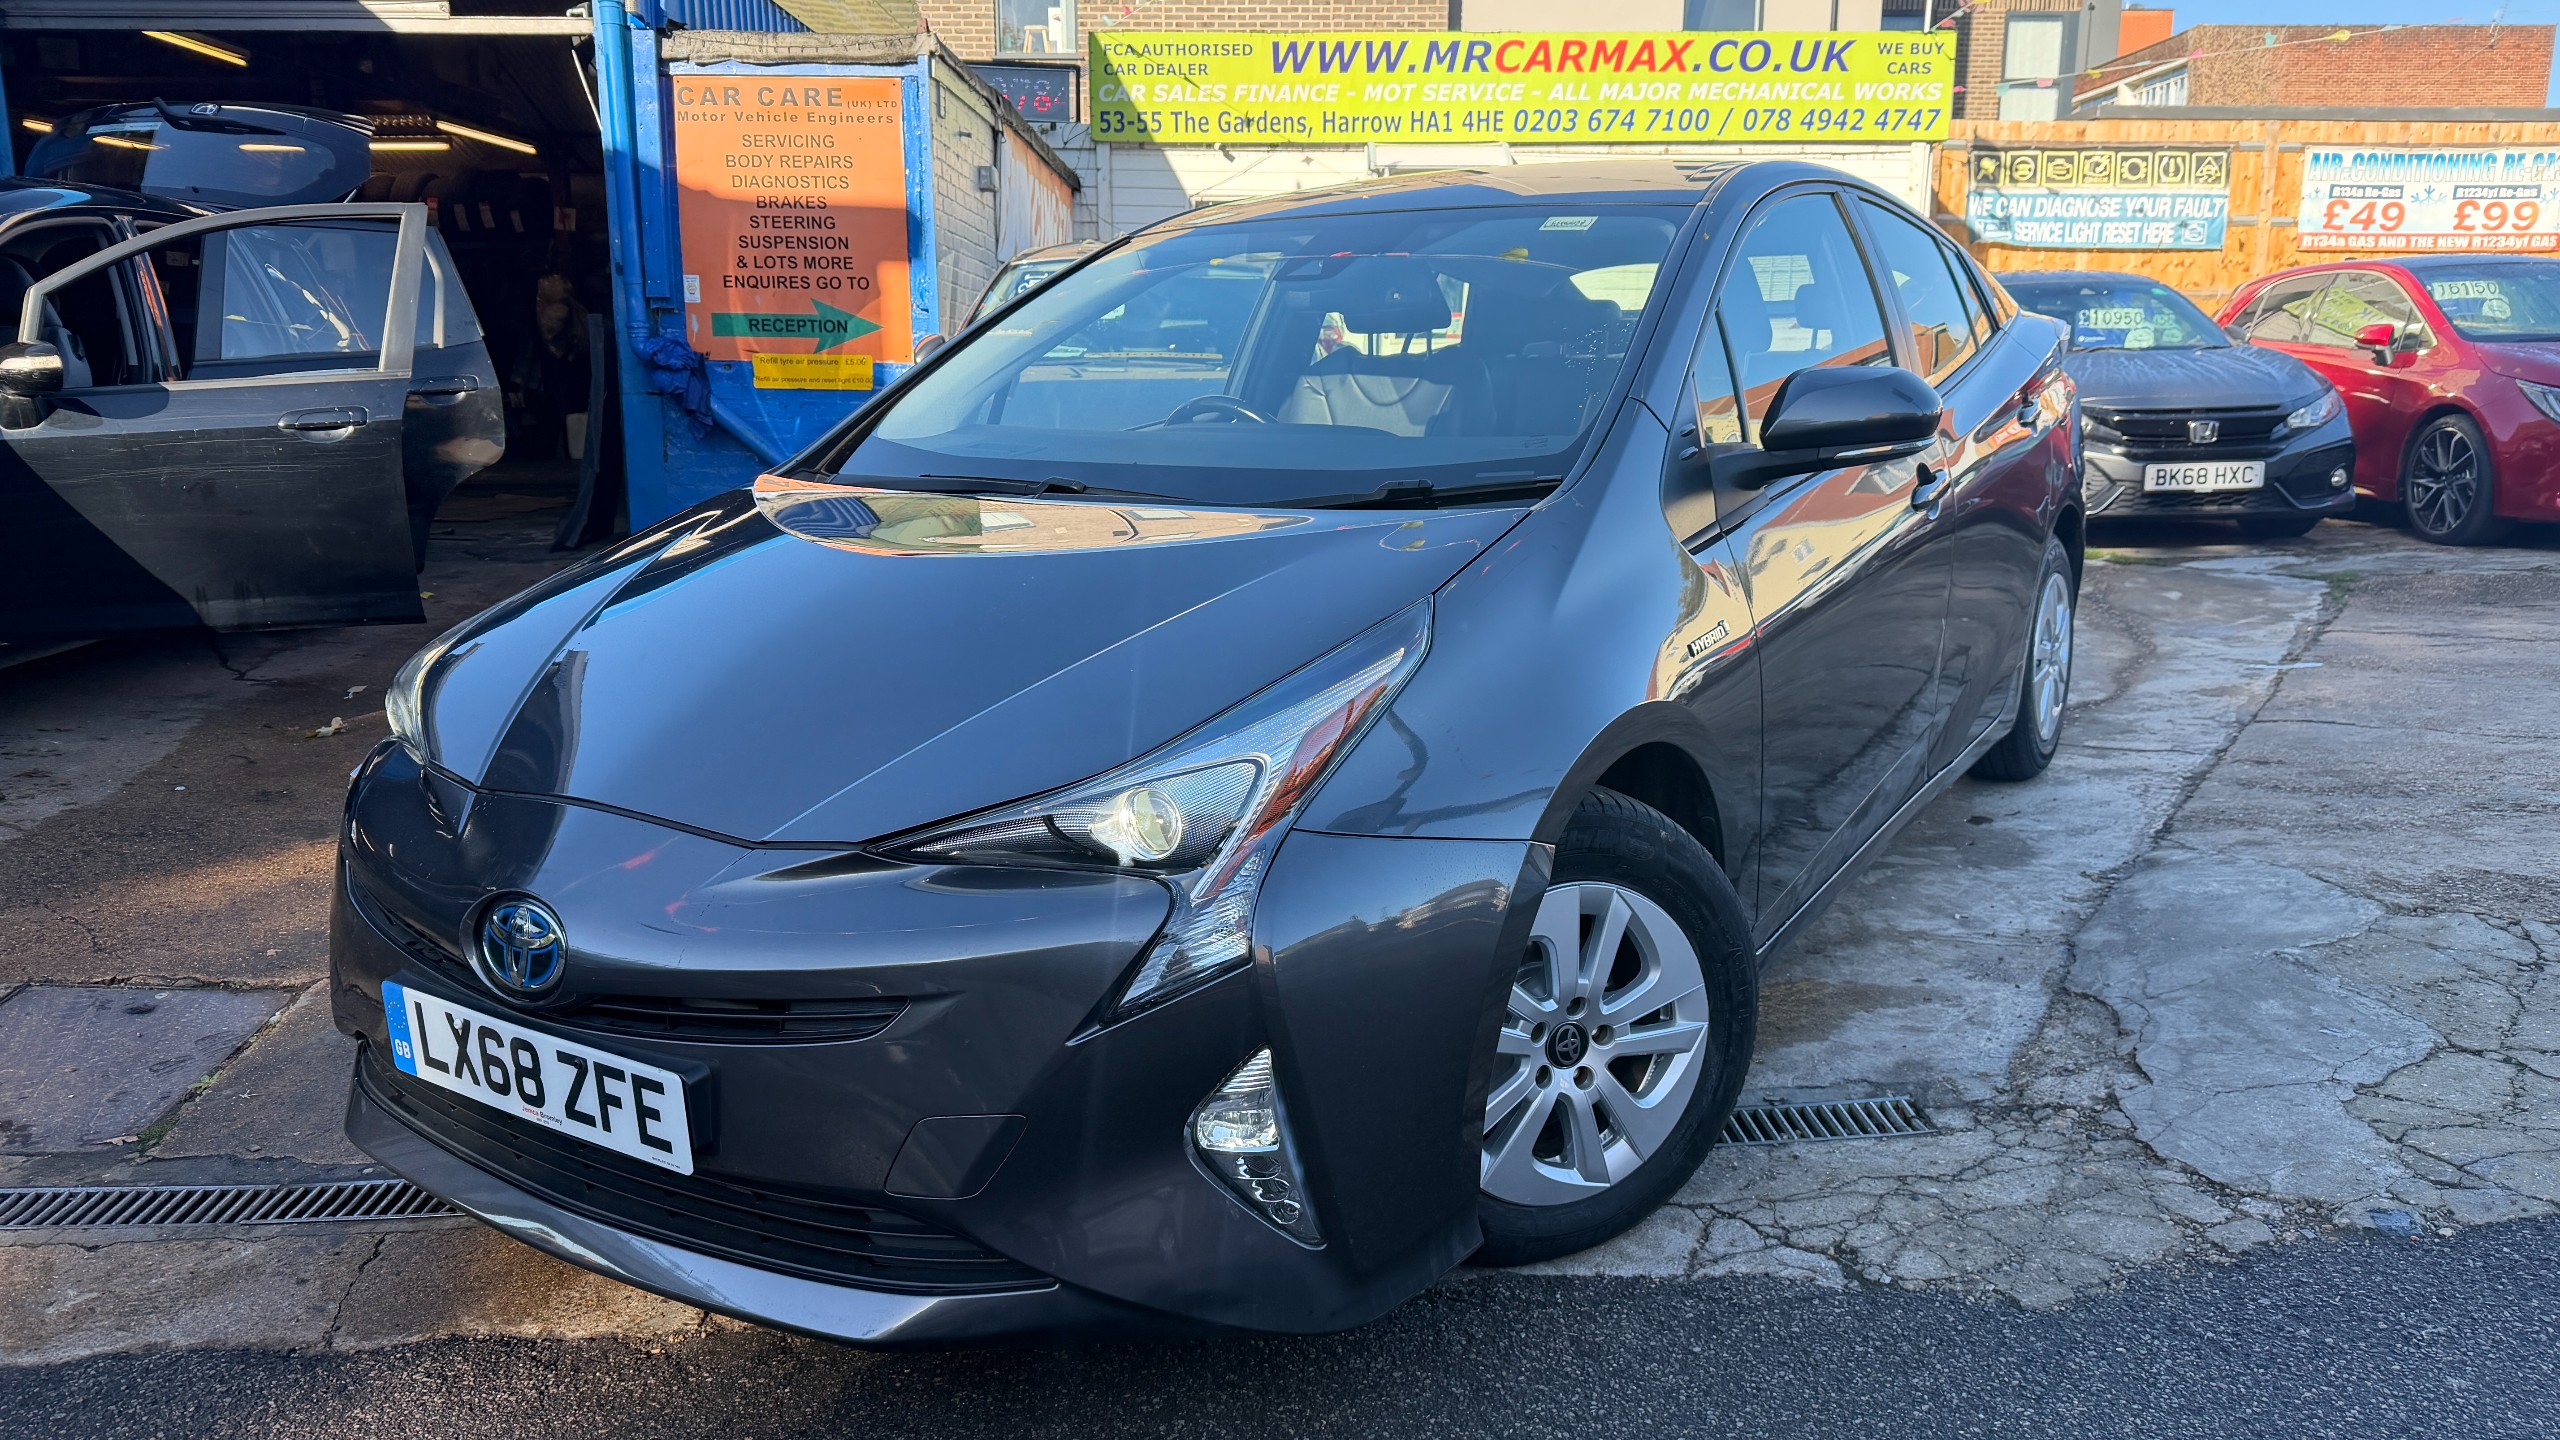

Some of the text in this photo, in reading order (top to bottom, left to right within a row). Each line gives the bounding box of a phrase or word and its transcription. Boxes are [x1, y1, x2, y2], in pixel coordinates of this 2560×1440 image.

[1103, 43, 1253, 56] FCA AUTHORISED
[1272, 39, 1857, 74] WWW.MRCARMAX.CO.UK
[1877, 42, 1945, 55] WE BUY
[1103, 63, 1209, 76] CAR DEALER
[1886, 61, 1932, 75] CARS
[677, 86, 898, 110] CAR CARE (UK) LTD
[1099, 83, 1146, 103] CAR
[1152, 83, 1227, 103] SALES
[1233, 83, 1341, 103] FINANCE
[1363, 83, 1417, 102] MOT
[1421, 82, 1526, 102] SERVICE
[1547, 82, 1591, 101] ALL
[1598, 82, 1682, 101] MAJOR
[1687, 82, 1845, 101] MECHANICAL
[1853, 82, 1944, 101] WORKS
[677, 111, 894, 126] Motor Vehicle Engineers
[1100, 107, 1942, 138] 53-55 The Gardens, Harrow HA1 4HE 0203 674 7100 / 078 4942 4747
[741, 134, 835, 149] SERVICING
[725, 154, 854, 169] BODY REPAIRS
[2308, 152, 2498, 182] AIR-CONDITIONING
[731, 174, 850, 190] DIAGNOSTICS
[756, 195, 828, 210] BRAKES
[1995, 196, 2033, 219] CAN
[2033, 196, 2123, 218] DIAGNOSE
[2125, 197, 2171, 219] YOUR
[2172, 197, 2225, 219] FAULT
[750, 215, 836, 230] STEERING
[2322, 198, 2406, 232] £49
[2452, 198, 2540, 232] £99
[2013, 220, 2177, 244] SERVICE LIGHT RESET HERE
[738, 235, 850, 250] SUSPENSION
[2347, 235, 2377, 248] GAS
[2377, 236, 2407, 249] AND
[2409, 235, 2436, 248] THE
[2436, 235, 2470, 249] NEW
[2530, 234, 2559, 248] GAS
[736, 255, 854, 270] & LOTS MORE
[723, 275, 870, 291] ENQUIRES GO TO
[748, 318, 849, 334] RECEPTION
[760, 356, 779, 365] Refill
[780, 358, 794, 367] tyre
[807, 359, 839, 367] pressure
[2154, 466, 2254, 486] BK68 HXC
[1690, 624, 1728, 656] HYBRID
[394, 1038, 412, 1060] GB
[413, 1000, 674, 1155] LX68 ZFE
[539, 1110, 563, 1127] Bromley
